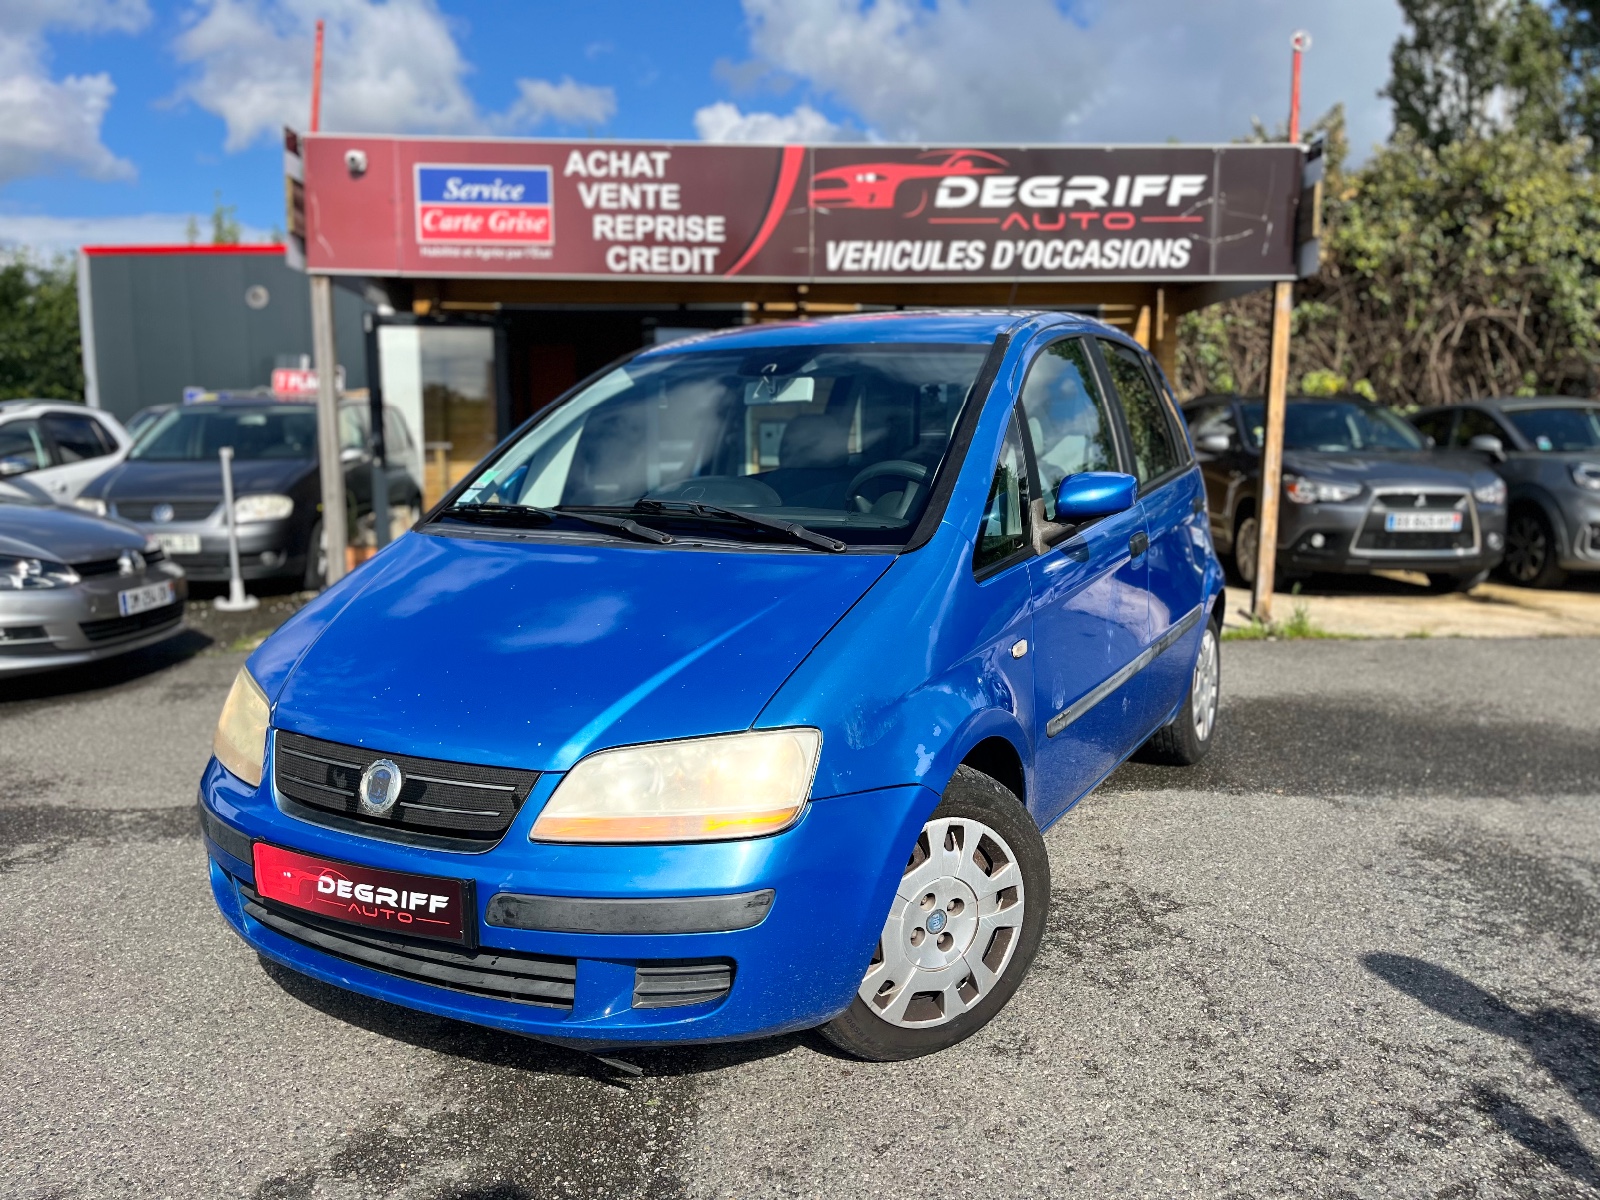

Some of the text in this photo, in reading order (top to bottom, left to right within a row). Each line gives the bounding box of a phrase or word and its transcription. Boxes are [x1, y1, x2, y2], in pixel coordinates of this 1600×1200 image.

[564, 150, 670, 178] ACHAT
[443, 176, 525, 201] Service
[578, 182, 680, 209] VENTE
[934, 174, 1207, 208] DEGRIFF
[423, 208, 547, 234] Carte Grise
[593, 215, 725, 243] REPRISE
[1002, 211, 1135, 230] AUTO
[606, 247, 719, 274] CREDIT
[826, 238, 1192, 271] VEHICULES D'OCCASIONS
[317, 875, 449, 914] DEGRIFF
[348, 903, 413, 924] AUTO
